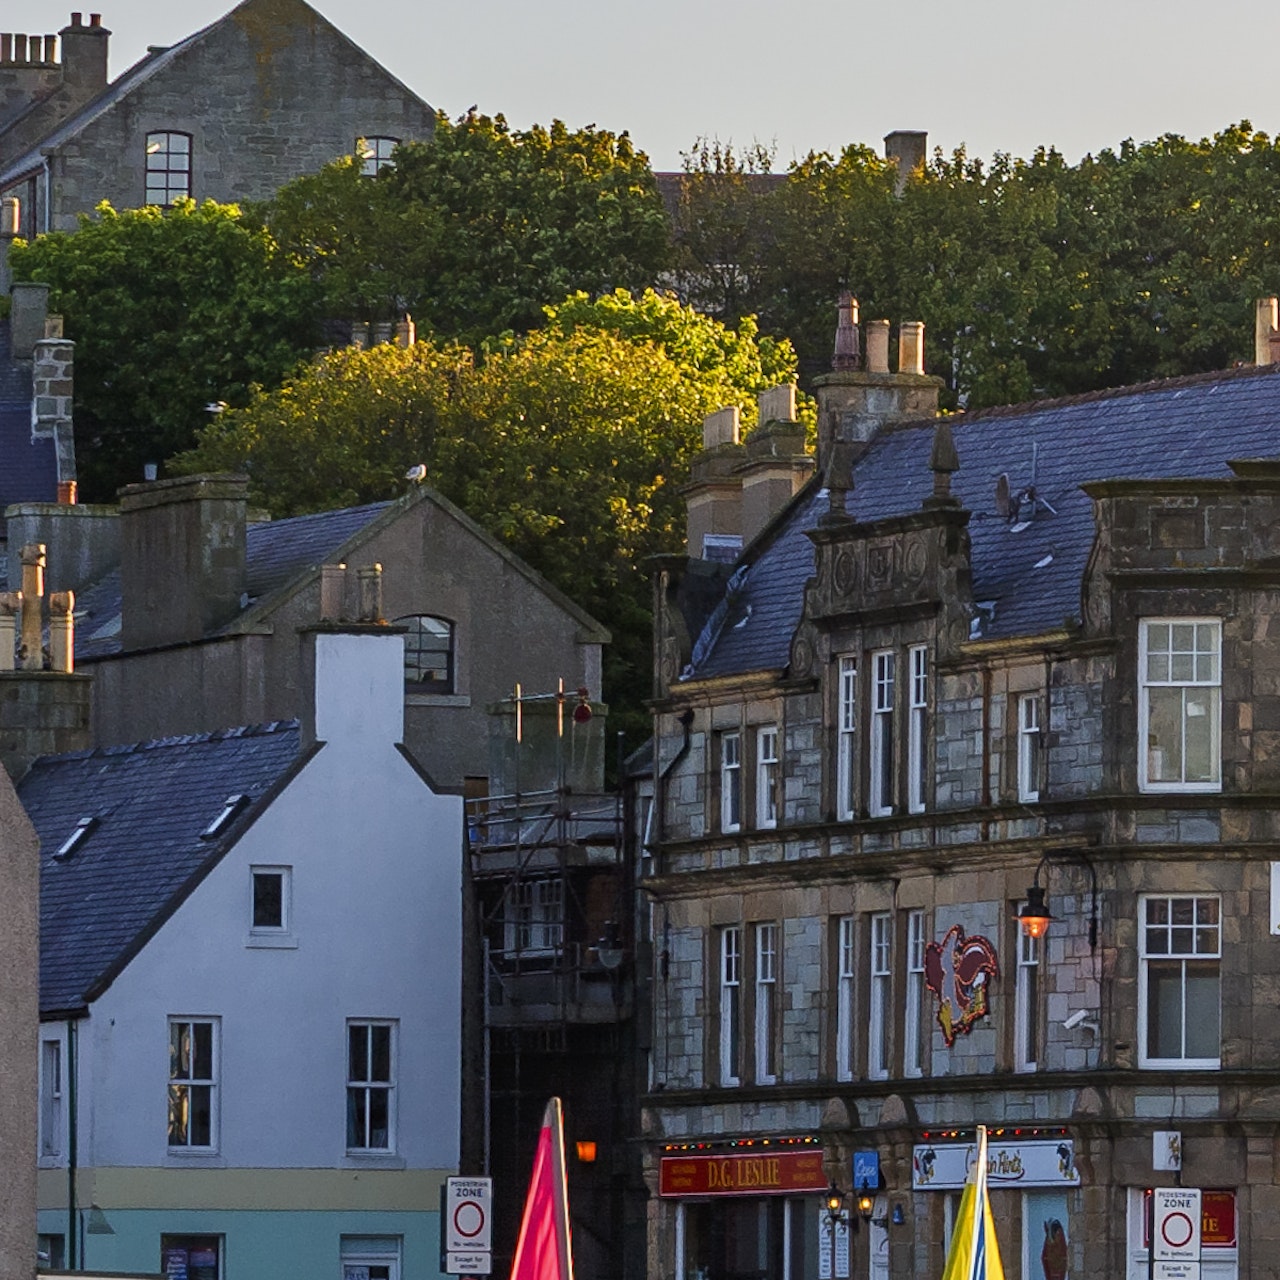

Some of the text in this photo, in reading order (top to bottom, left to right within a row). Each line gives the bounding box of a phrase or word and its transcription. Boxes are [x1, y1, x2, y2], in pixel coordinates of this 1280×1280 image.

[707, 1160, 733, 1188] D.G.
[736, 1158, 780, 1187] LESLIE
[456, 1188, 483, 1197] ZONE
[1163, 1200, 1192, 1208] ZONE
